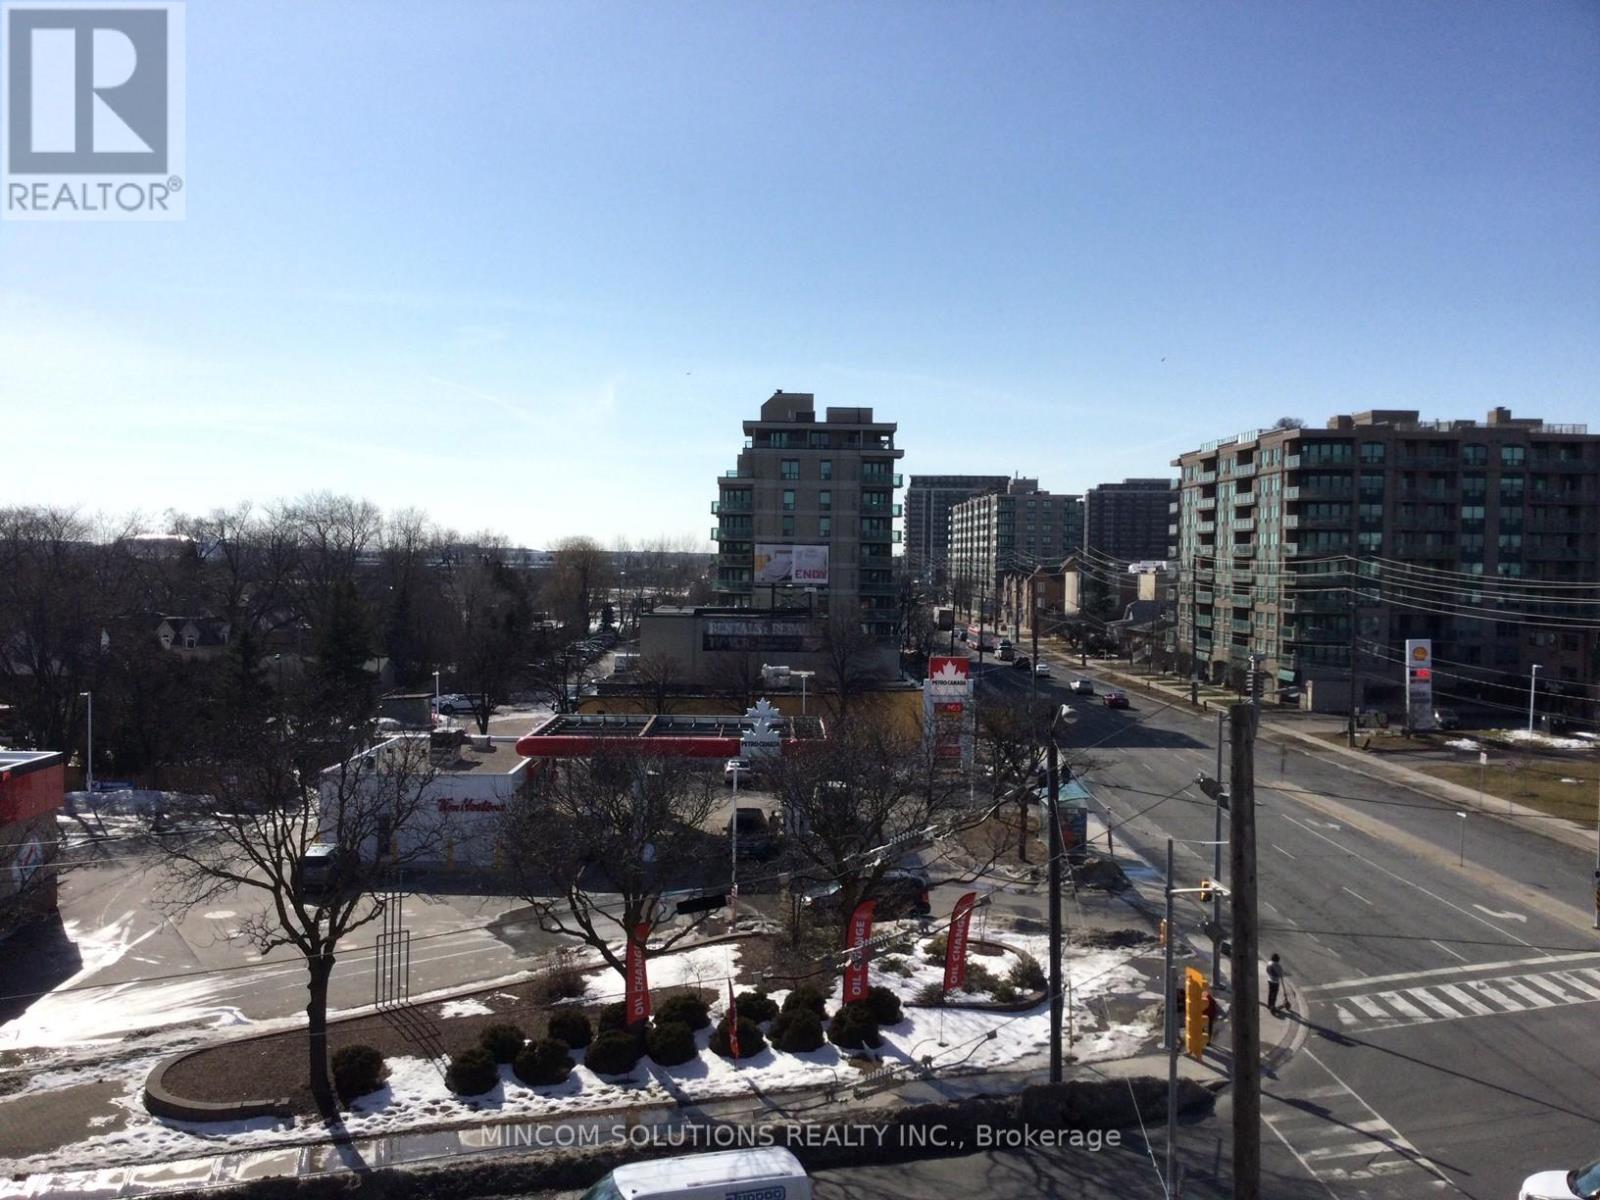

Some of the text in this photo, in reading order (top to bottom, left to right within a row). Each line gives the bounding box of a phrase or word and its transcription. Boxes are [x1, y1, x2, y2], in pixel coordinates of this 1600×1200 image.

[950, 969, 960, 984] OIL
[852, 977, 861, 996] OIL
[634, 996, 645, 1015] OIL
